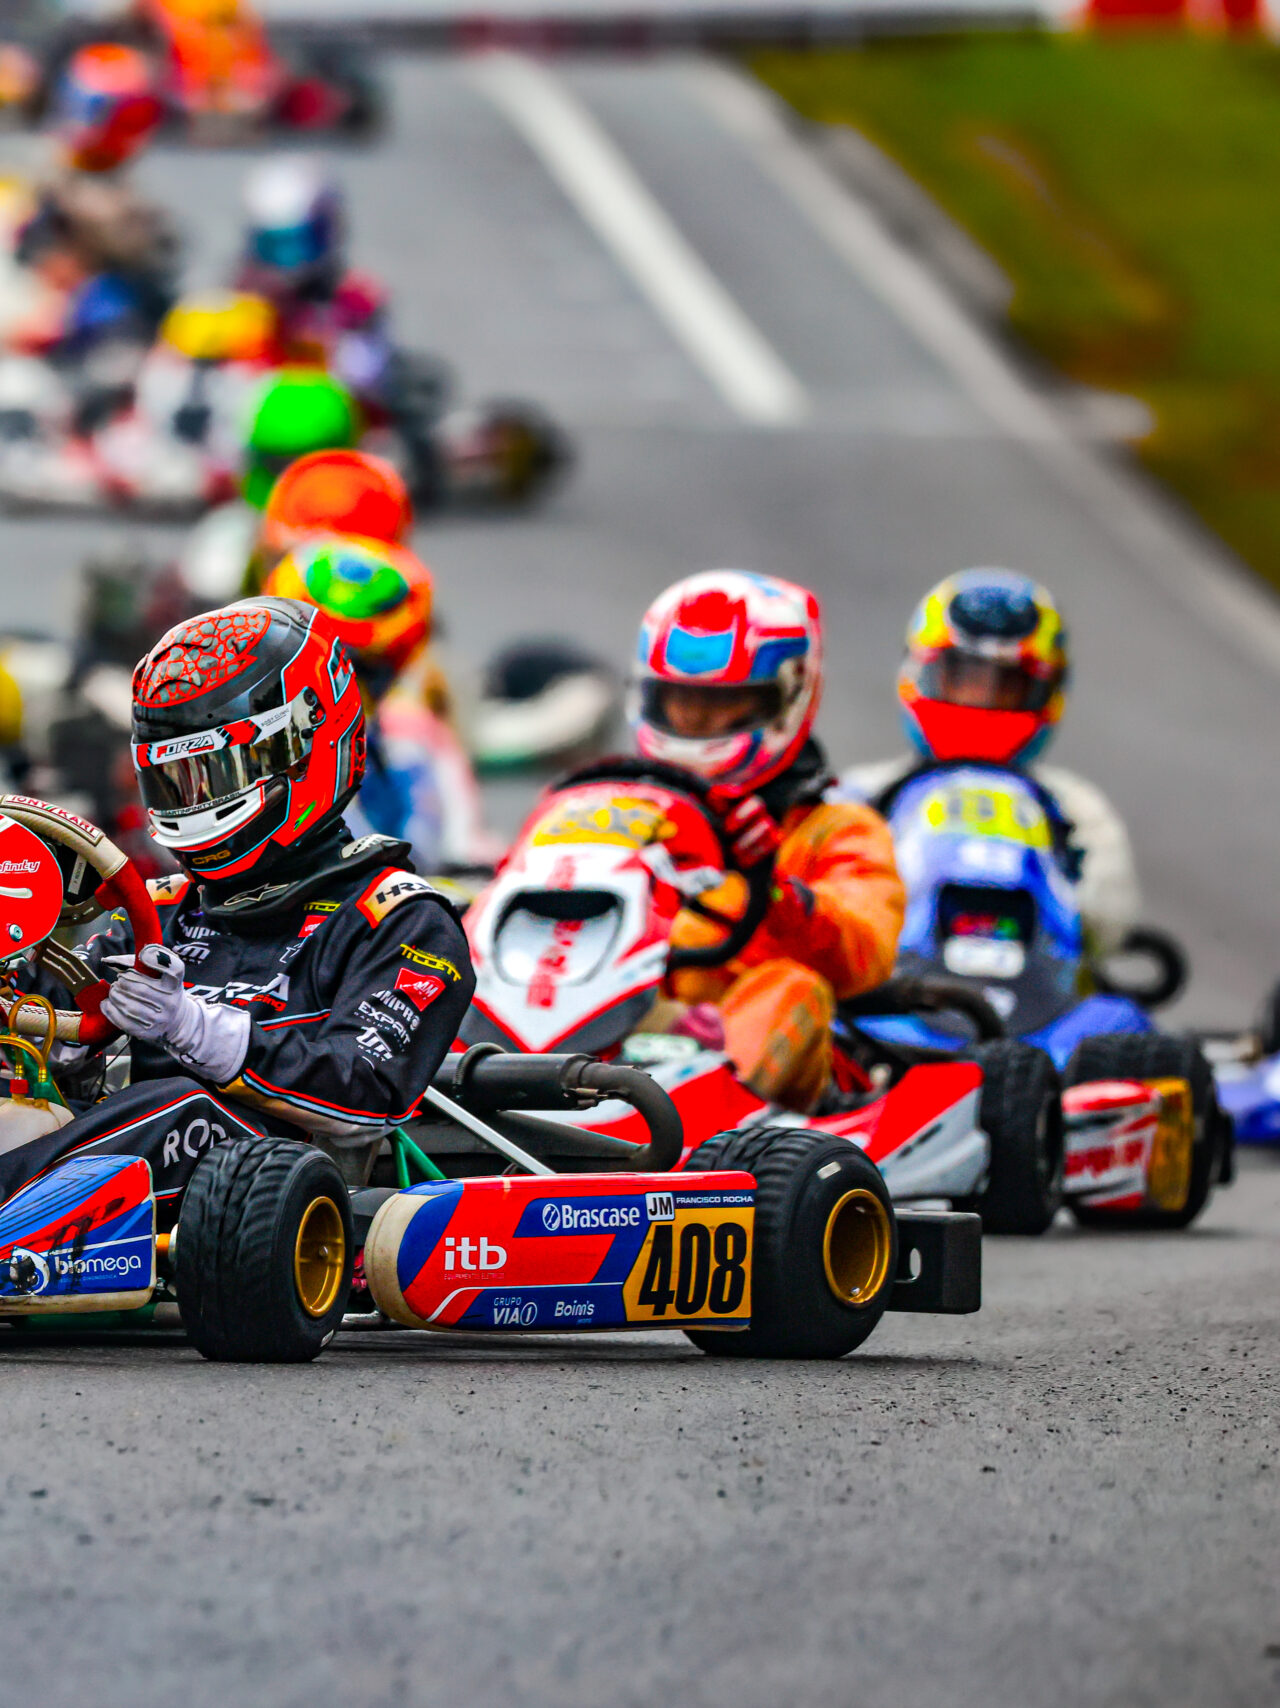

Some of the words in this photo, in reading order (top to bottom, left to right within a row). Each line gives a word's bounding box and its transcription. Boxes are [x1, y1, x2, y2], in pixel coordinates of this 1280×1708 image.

[157, 735, 215, 758] FORZA
[192, 850, 231, 866] CRG
[400, 943, 462, 982] TILLETT
[358, 1001, 411, 1045] EXPRIT
[648, 1197, 673, 1216] JM
[676, 1196, 721, 1204] FRANCISCO
[561, 1204, 641, 1229] Brascase
[54, 1255, 141, 1276] biomega
[444, 1237, 508, 1271] itb
[638, 1222, 748, 1316] 408
[493, 1297, 522, 1306] GRUPO
